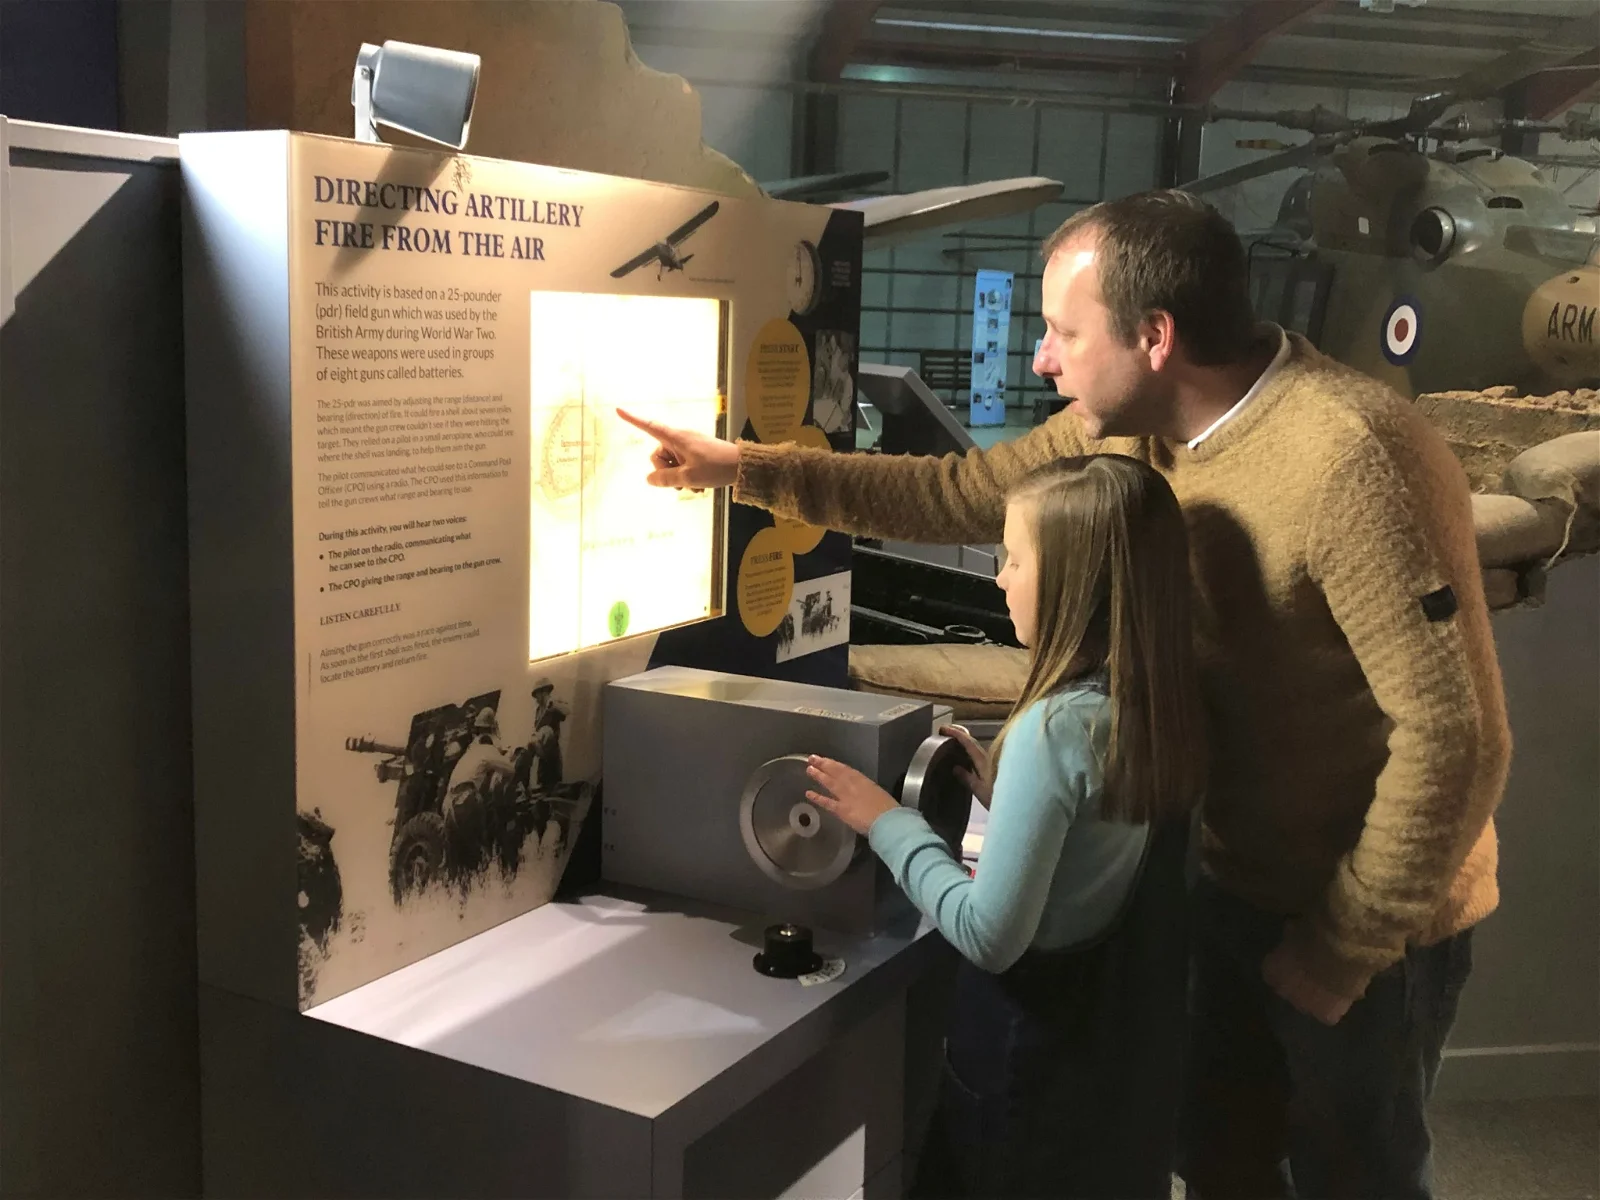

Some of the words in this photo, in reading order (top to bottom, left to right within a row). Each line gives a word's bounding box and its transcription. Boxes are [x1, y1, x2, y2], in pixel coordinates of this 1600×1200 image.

[314, 175, 459, 215] DIRECTING
[465, 193, 584, 228] ARTILLERY
[315, 219, 375, 249] FIRE
[381, 224, 452, 254] FROM
[458, 231, 505, 258] THE
[510, 236, 545, 261] AIR
[315, 281, 339, 296] This
[341, 284, 380, 300] activity
[383, 285, 391, 298] is
[394, 285, 423, 300] based
[425, 290, 438, 300] on
[440, 290, 446, 300] a
[447, 288, 502, 303] 25-pounder
[315, 303, 342, 320] (pdr)
[345, 304, 368, 318] field
[370, 308, 390, 322] gun
[392, 305, 422, 319] which
[424, 310, 443, 320] was
[445, 308, 468, 320] used
[469, 308, 480, 323] by
[482, 308, 498, 320] the
[316, 324, 353, 339] British
[355, 325, 384, 341] Army
[386, 326, 420, 342] during
[421, 326, 452, 340] World
[454, 326, 474, 339] War
[476, 327, 497, 340] Two.
[316, 346, 349, 360] These
[351, 348, 398, 362] weapons
[400, 349, 426, 359] were
[427, 346, 450, 359] used
[452, 346, 461, 359] in
[463, 349, 495, 362] groups
[316, 367, 328, 381] of
[330, 367, 358, 384] eight
[360, 369, 385, 383] guns
[387, 365, 417, 379] called
[419, 365, 464, 379] batteries.
[317, 399, 330, 409] The
[332, 399, 355, 409] 25-pdr
[372, 398, 392, 407] aimed
[394, 397, 401, 406] by
[402, 397, 432, 405] adjusting
[433, 396, 443, 404] the
[444, 396, 462, 404] range
[492, 393, 503, 402] and
[317, 426, 339, 435] which
[340, 425, 362, 434] meant
[363, 424, 374, 433] the
[375, 425, 389, 434] gun
[389, 424, 406, 432] crew
[407, 420, 432, 430] couldn't
[433, 421, 444, 429] see
[445, 420, 449, 428] if
[450, 419, 463, 428] they
[480, 418, 500, 427] hitting
[501, 417, 510, 425] the
[317, 452, 341, 462] where
[341, 452, 353, 461] the
[354, 450, 370, 459] shell
[371, 450, 385, 458] was
[412, 447, 419, 455] to
[420, 444, 434, 456] help
[435, 444, 451, 453] them
[464, 443, 474, 451] the
[318, 473, 332, 482] The
[333, 471, 349, 482] pilot
[350, 468, 400, 479] communicated
[401, 466, 416, 475] what
[417, 464, 426, 473] he
[426, 463, 444, 472] could
[456, 462, 463, 470] to
[468, 458, 498, 469] Command
[318, 485, 342, 496] Officer
[345, 482, 365, 494] (CPO)
[366, 482, 385, 491] using
[411, 477, 422, 486] The
[423, 475, 439, 485] CPO
[440, 474, 454, 483] used
[455, 474, 467, 482] this
[467, 471, 501, 480] information
[319, 499, 330, 509] tell
[331, 498, 343, 507] the
[344, 499, 358, 508] gun
[359, 496, 379, 504] crews
[380, 493, 396, 502] what
[397, 491, 416, 501] range
[417, 489, 429, 498] and
[429, 487, 453, 496] bearing
[454, 486, 461, 494] to
[319, 531, 344, 541] During
[345, 528, 359, 538] this
[360, 525, 388, 536] activity,
[389, 524, 402, 533] you
[403, 520, 415, 530] will
[416, 519, 431, 528] hear
[328, 550, 342, 560] The
[343, 547, 360, 559] pilot
[361, 547, 371, 555] on
[372, 544, 383, 553] the
[405, 534, 455, 548] communicating
[456, 532, 472, 541] what
[329, 564, 339, 572] he
[339, 563, 353, 571] can
[354, 560, 366, 568] see
[367, 559, 375, 567] to
[376, 556, 388, 565] the
[328, 582, 343, 592] The
[343, 579, 361, 589] CPO
[361, 576, 382, 588] giving
[383, 574, 395, 583] the
[396, 571, 415, 581] range
[416, 568, 429, 577] and
[429, 564, 454, 574] bearing
[462, 560, 473, 569] the
[473, 560, 485, 569] gun
[320, 612, 351, 626] LISTEN
[353, 603, 402, 620] CAREFULLY
[320, 673, 342, 684] locate
[343, 670, 355, 679] the
[355, 665, 380, 677] battery
[382, 659, 394, 670] and
[395, 655, 415, 667] return
